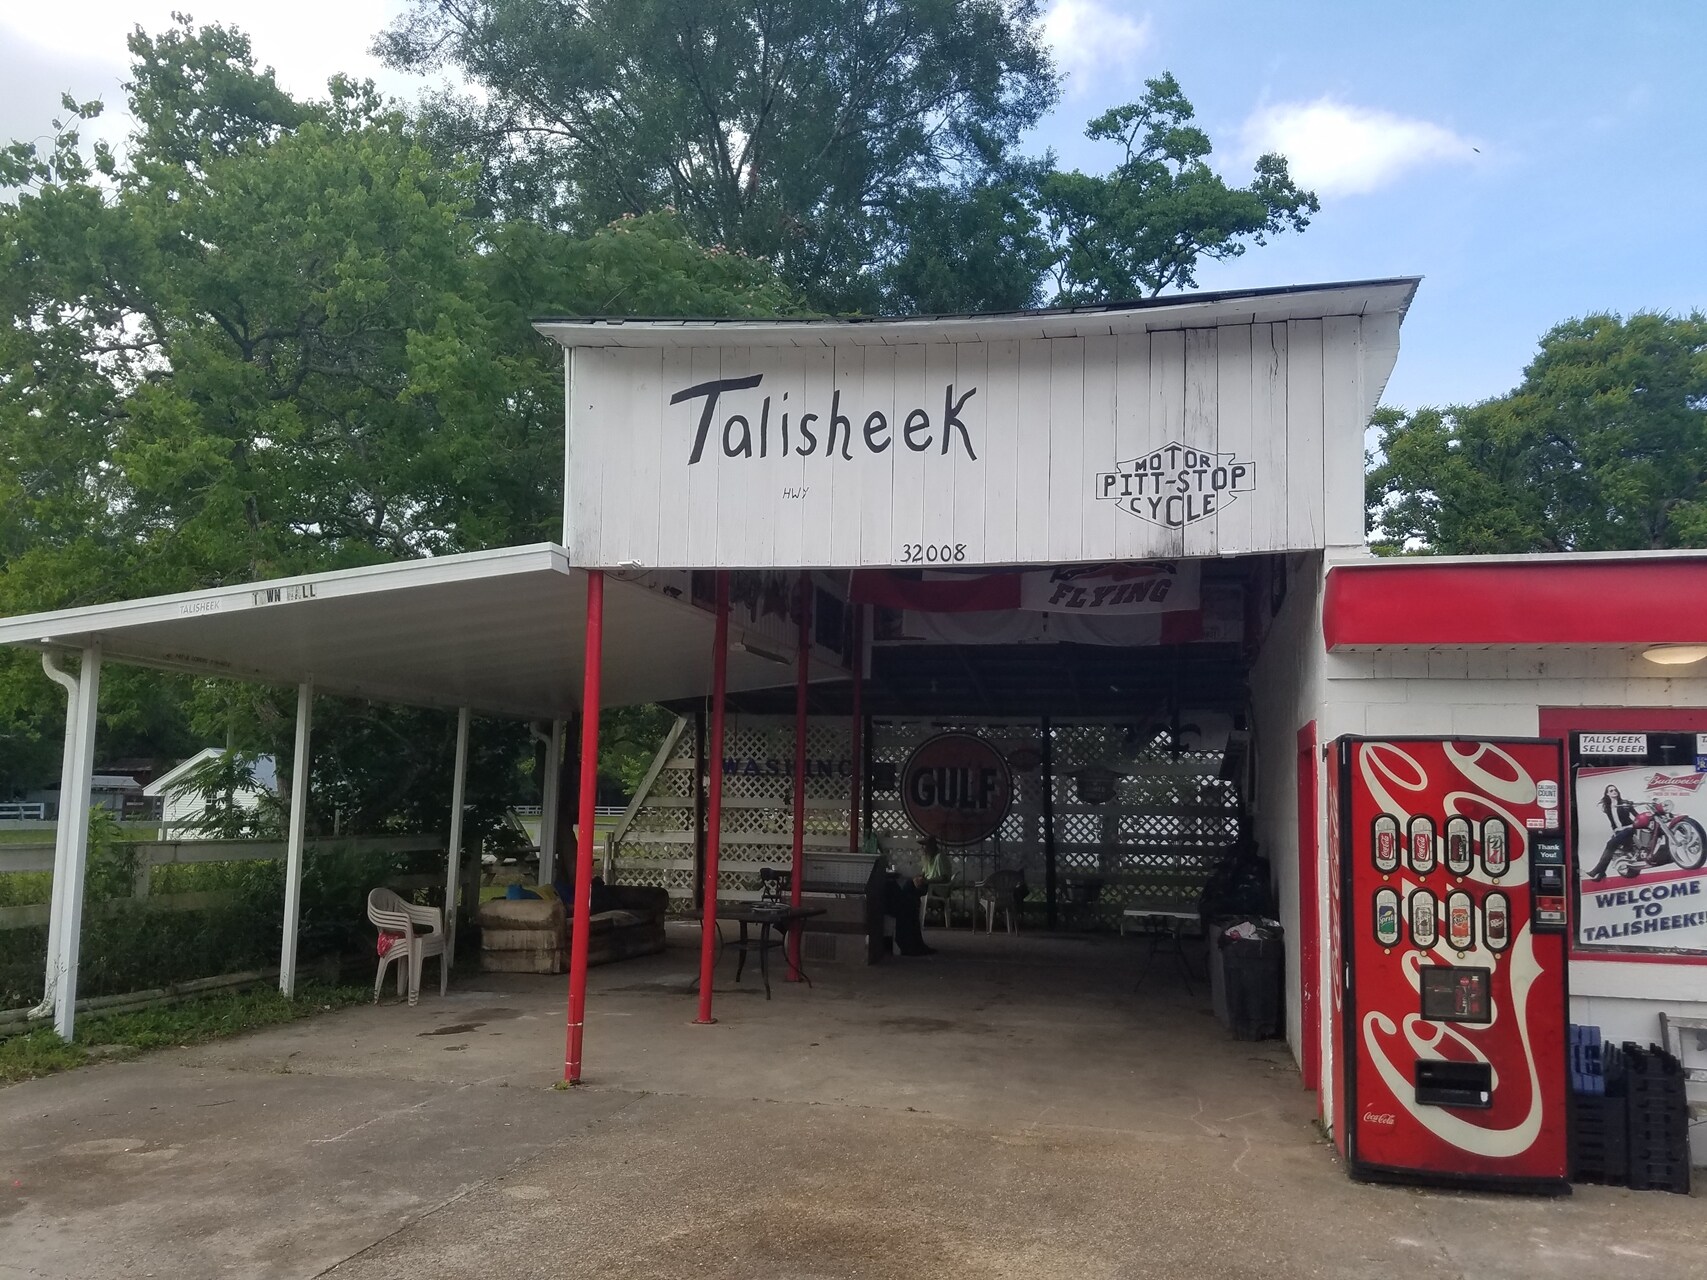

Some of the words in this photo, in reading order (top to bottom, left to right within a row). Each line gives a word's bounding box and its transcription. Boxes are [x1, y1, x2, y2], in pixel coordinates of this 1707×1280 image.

[1134, 445, 1212, 472] MOTOR
[782, 487, 810, 500] HWY
[1103, 465, 1246, 497] PITT-STOP
[1130, 494, 1216, 526] CYCLE
[900, 543, 967, 563] 32008
[179, 600, 220, 615] TALISHEEK
[252, 588, 281, 606] TWN
[1048, 578, 1173, 609] FLYING
[1582, 735, 1642, 744] TALISHEEK
[1582, 744, 1614, 753] SELLS
[1616, 745, 1645, 753] BEER
[911, 767, 1000, 809] GULF
[1595, 880, 1701, 909] WELCOME
[1632, 902, 1663, 919] TO
